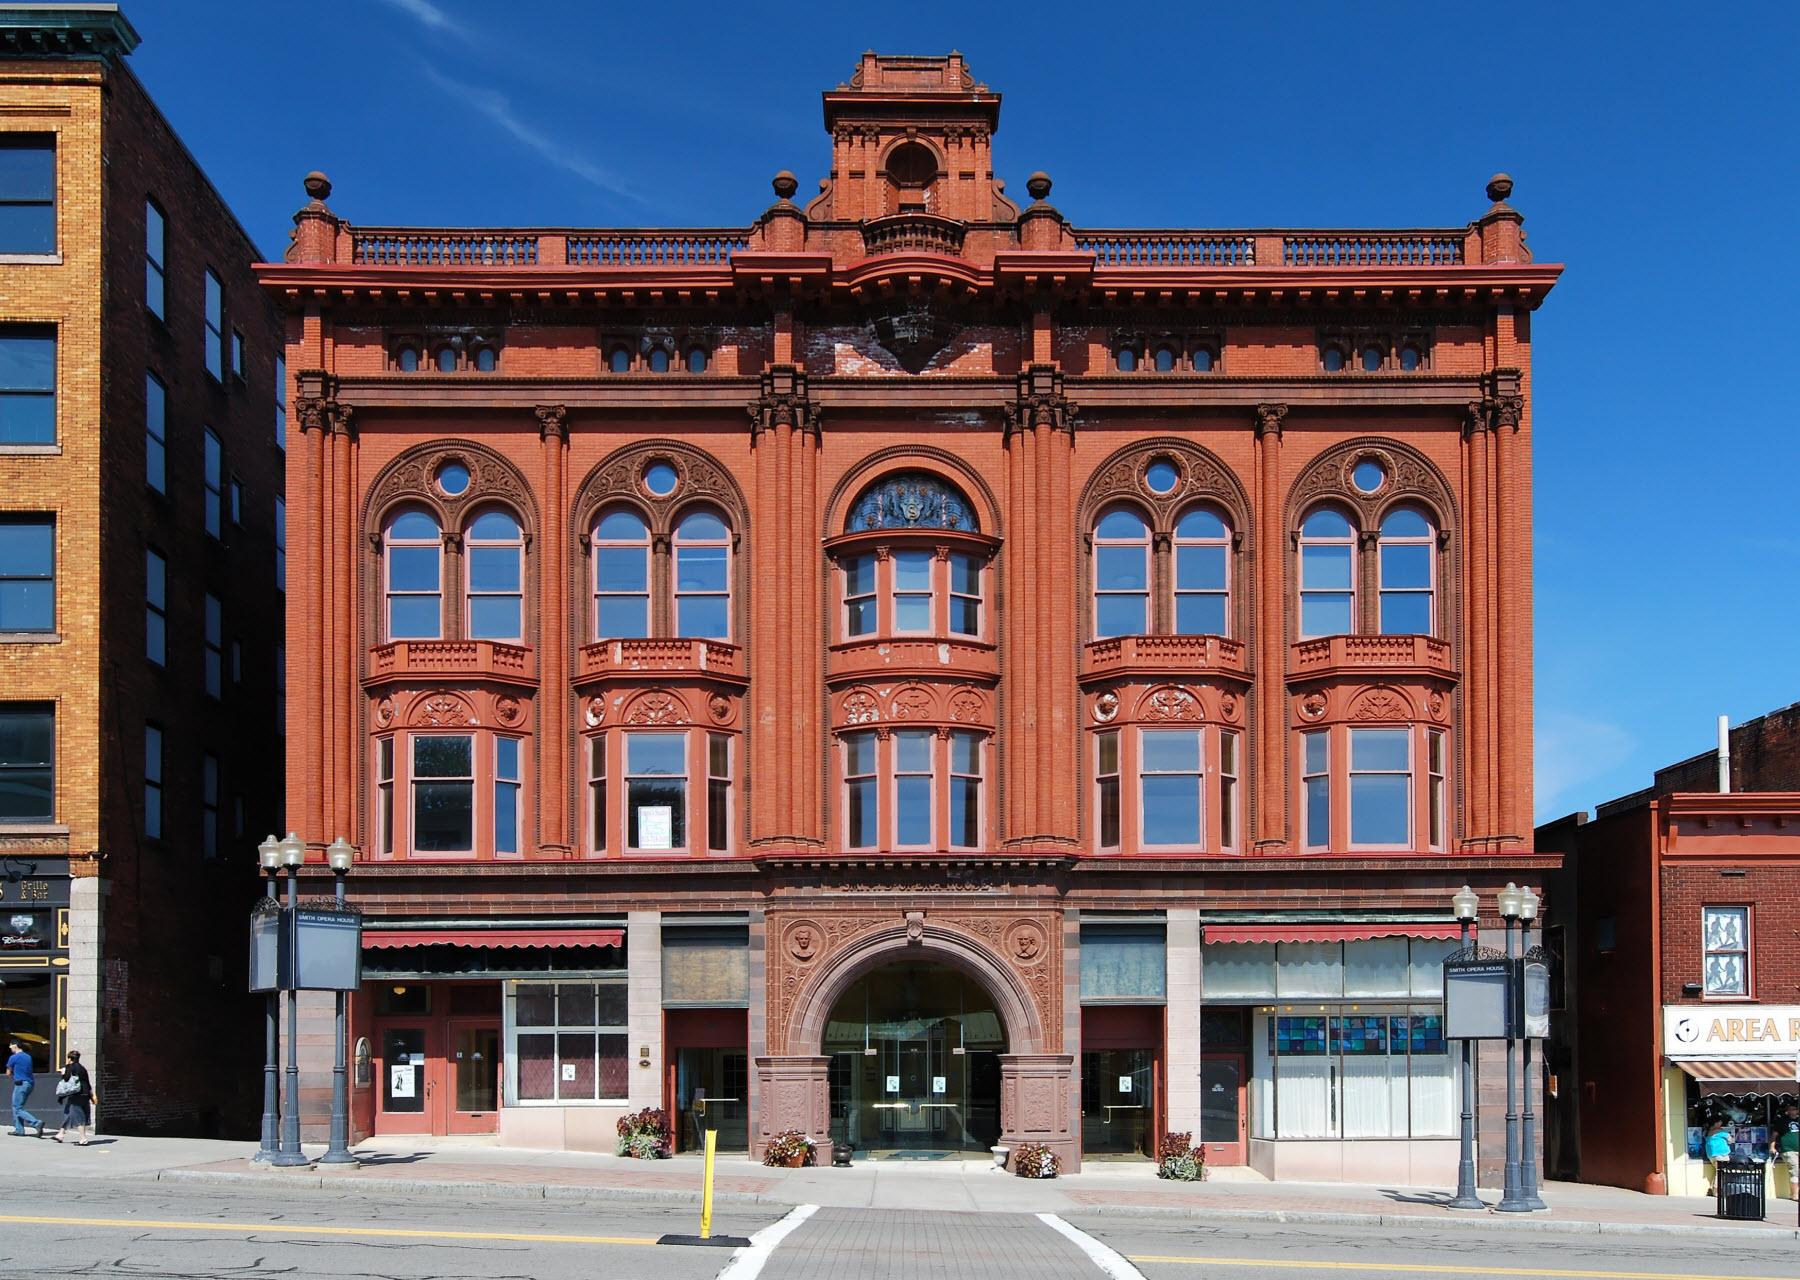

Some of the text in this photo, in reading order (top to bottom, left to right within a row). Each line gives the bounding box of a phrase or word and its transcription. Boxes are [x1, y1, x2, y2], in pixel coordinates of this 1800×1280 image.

[21, 890, 48, 900] & Bar
[1706, 1018, 1782, 1042] AREA
